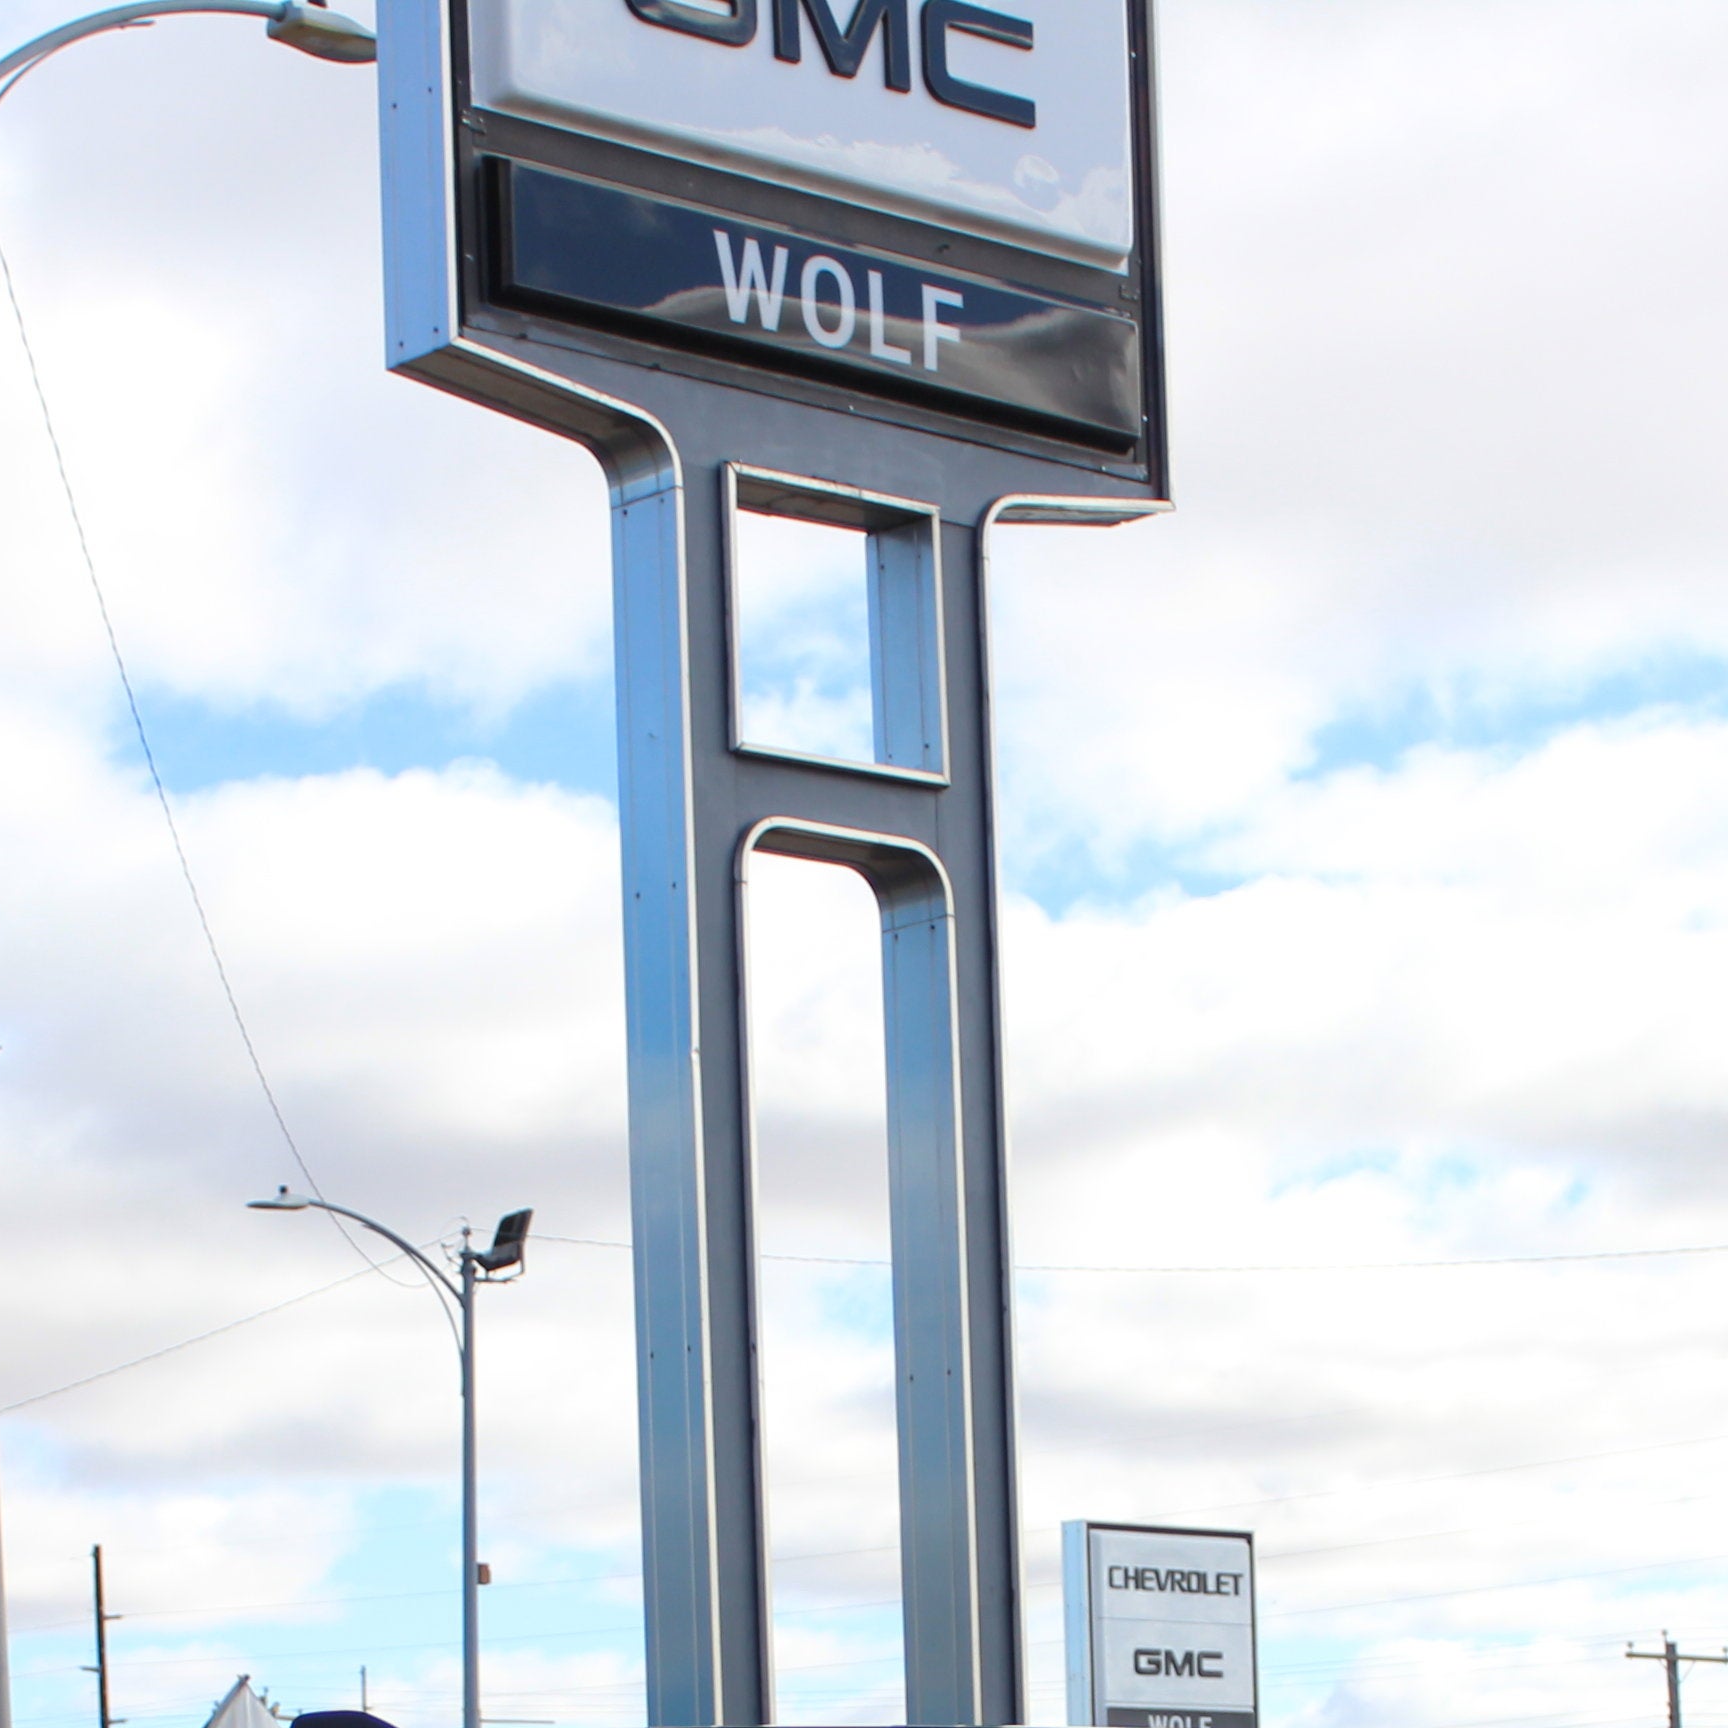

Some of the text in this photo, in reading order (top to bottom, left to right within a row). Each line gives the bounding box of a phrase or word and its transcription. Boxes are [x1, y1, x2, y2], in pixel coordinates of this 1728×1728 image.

[713, 228, 964, 371] WOLF
[1108, 1566, 1243, 1596] CHEVROLET
[1133, 1648, 1224, 1678] GMC
